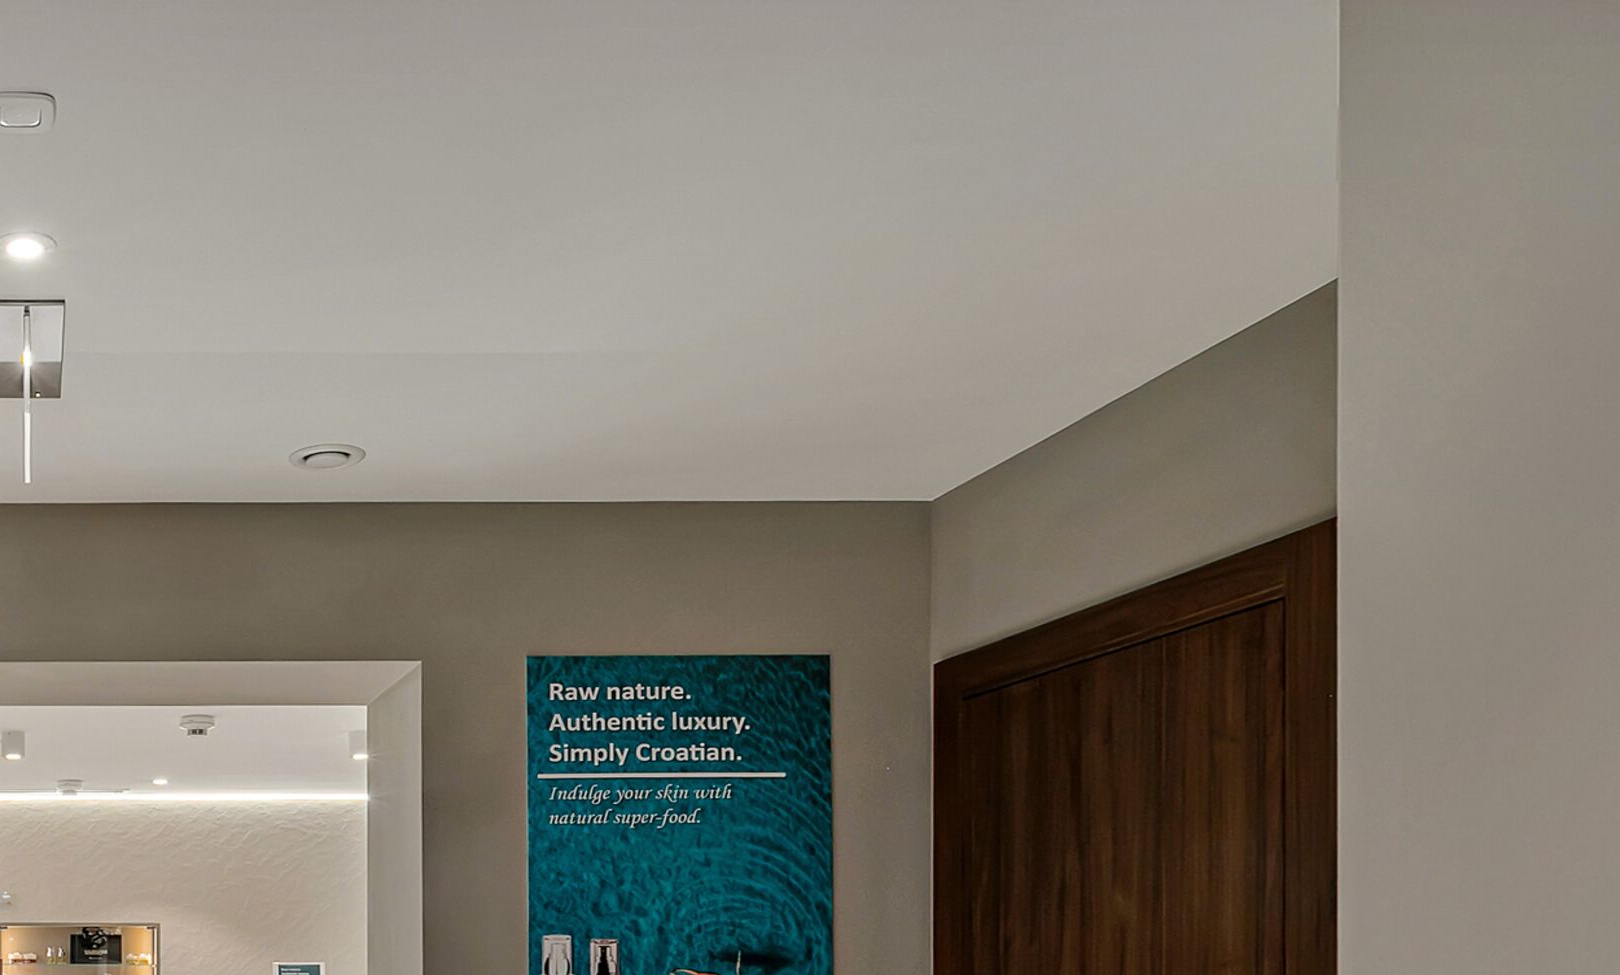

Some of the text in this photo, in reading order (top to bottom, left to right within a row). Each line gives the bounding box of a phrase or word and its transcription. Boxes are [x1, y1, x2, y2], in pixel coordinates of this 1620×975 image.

[548, 683, 692, 701] Raw nature.
[548, 712, 751, 735] Authentic luxury.
[548, 743, 742, 766] Simply Croatian.
[549, 783, 732, 805] Indulge your skin with
[549, 807, 702, 828] natural super-food.
